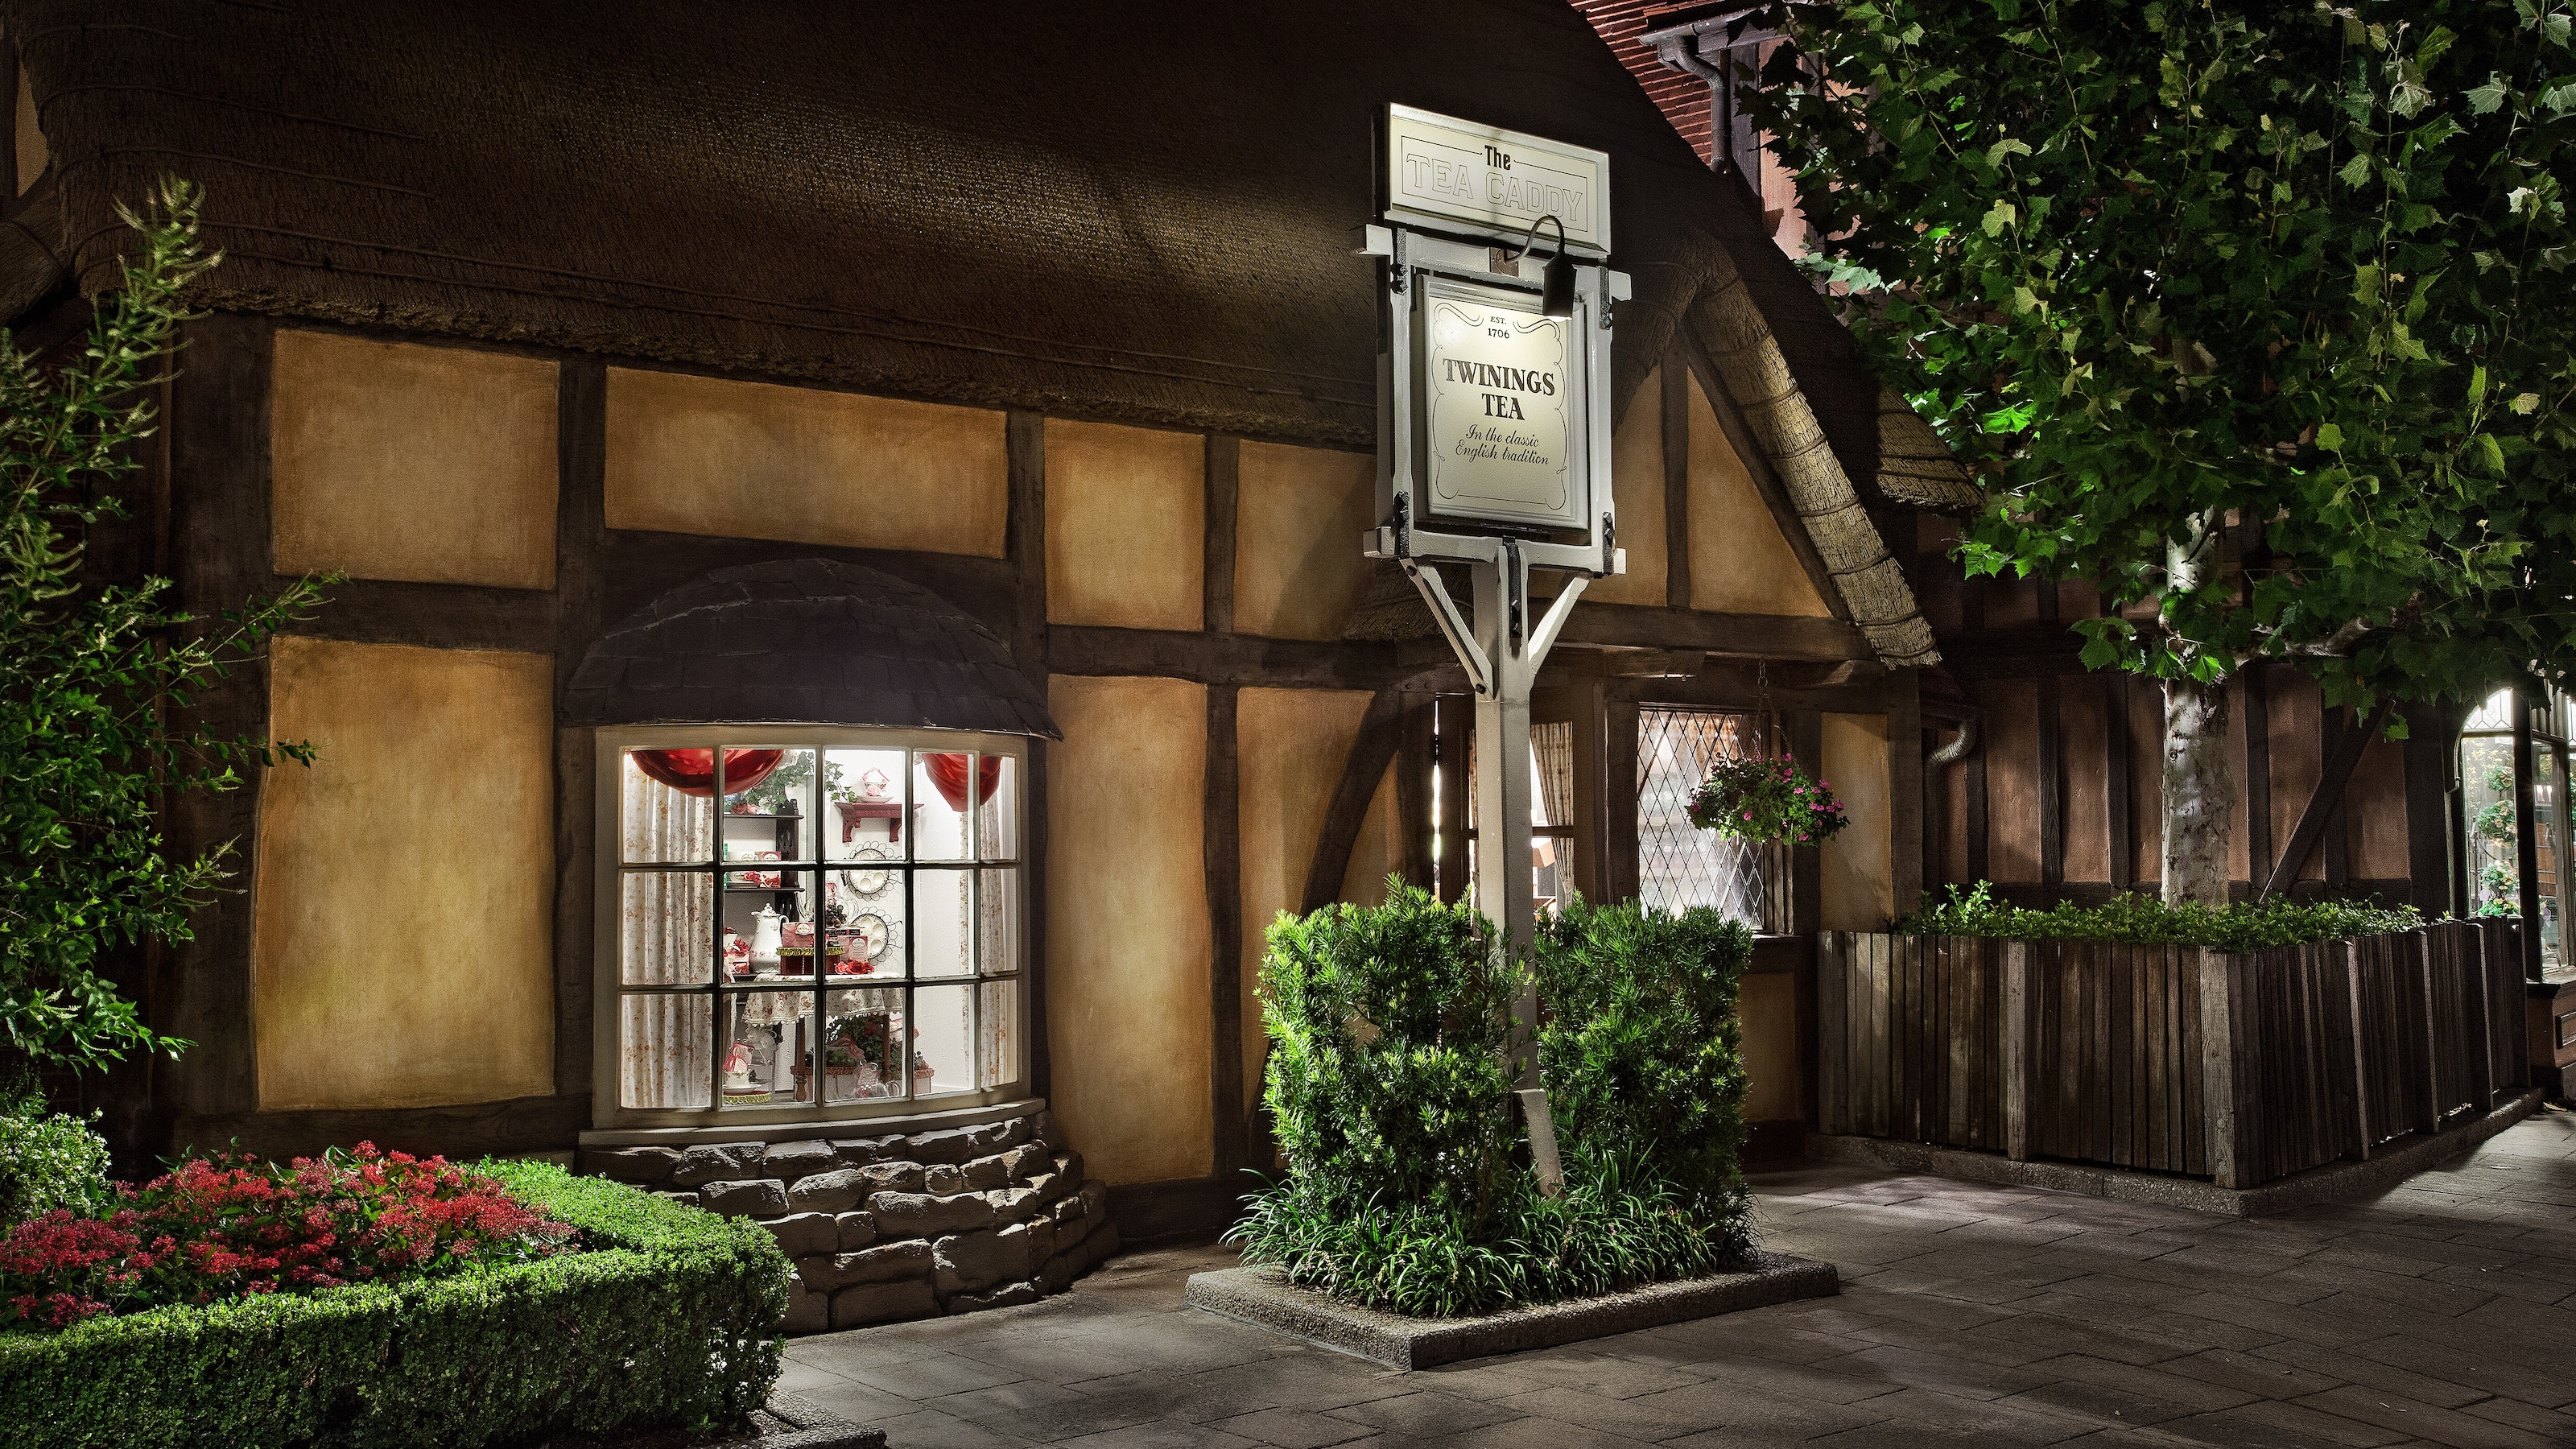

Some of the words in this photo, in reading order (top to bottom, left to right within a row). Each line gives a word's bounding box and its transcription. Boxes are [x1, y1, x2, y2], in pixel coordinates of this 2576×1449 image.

[1484, 145, 1511, 171] The
[1406, 153, 1474, 200] TEA
[1485, 171, 1583, 221] CADDY
[1490, 316, 1507, 324] EST.
[1488, 328, 1510, 339] 1706
[1443, 358, 1555, 396] TWININGS
[1481, 393, 1525, 421] TEA
[1465, 423, 1483, 440] In
[1485, 427, 1503, 443] the
[1505, 430, 1539, 448] classic
[1455, 440, 1497, 462] English
[1502, 448, 1550, 465] tradition
